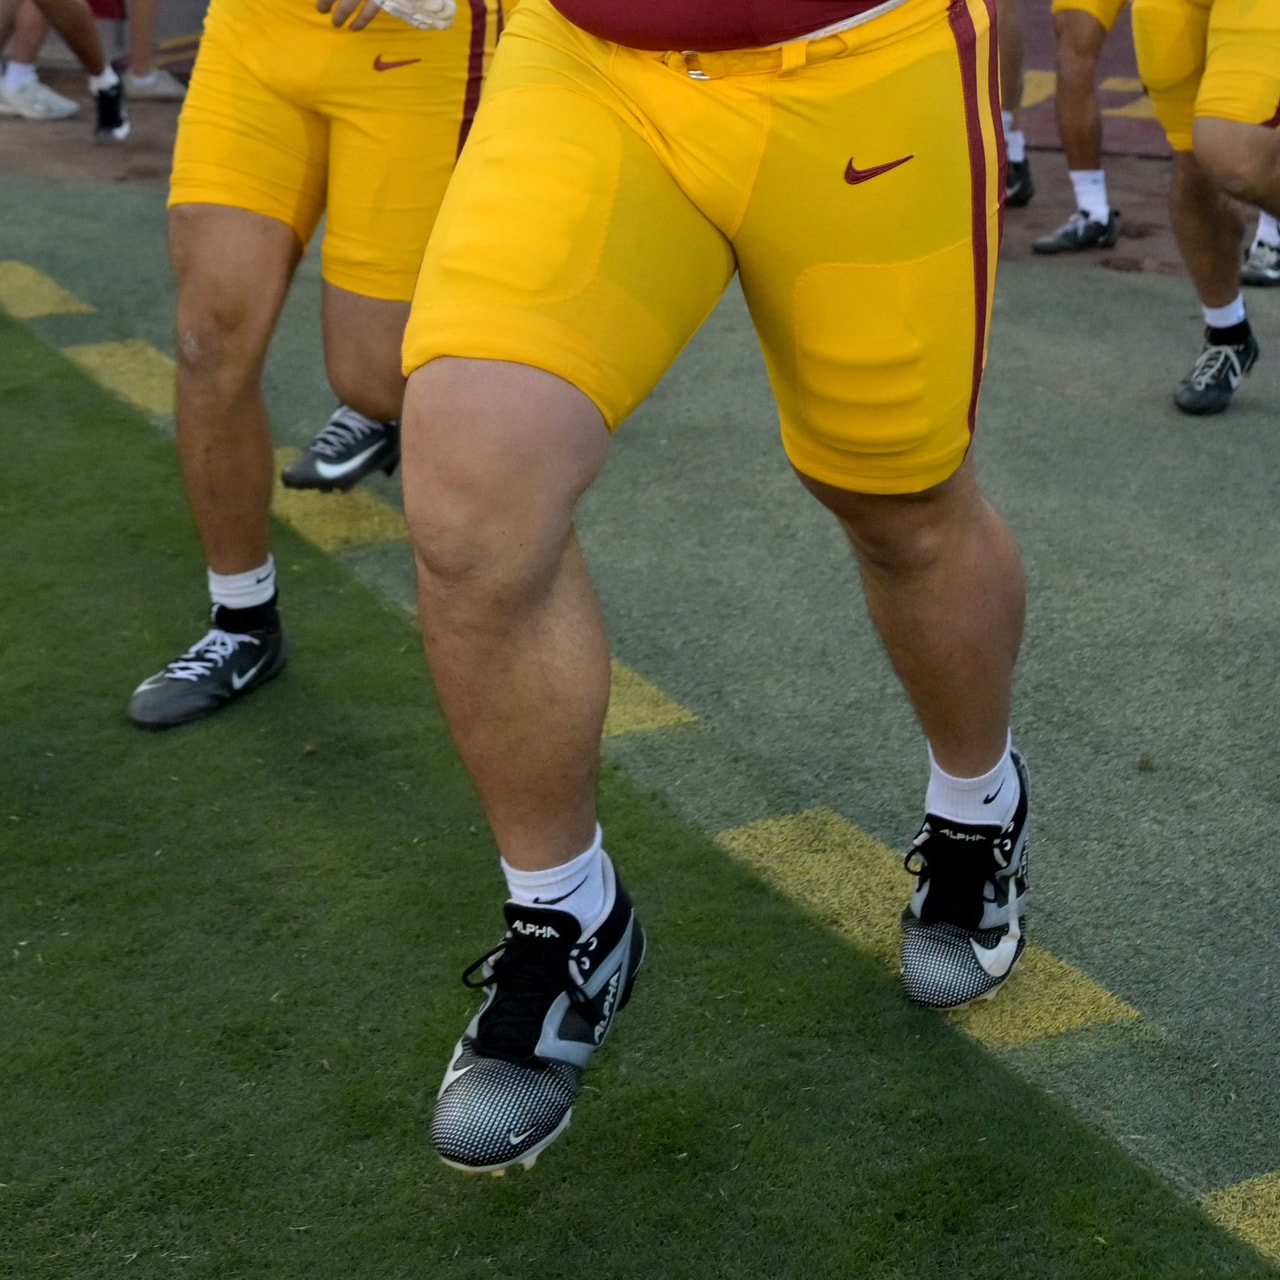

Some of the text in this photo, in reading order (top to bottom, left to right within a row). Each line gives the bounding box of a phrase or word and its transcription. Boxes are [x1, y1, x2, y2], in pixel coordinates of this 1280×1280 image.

[939, 828, 986, 842] ALPHA
[511, 919, 560, 938] ALPHA
[594, 970, 620, 1044] ALPHA
